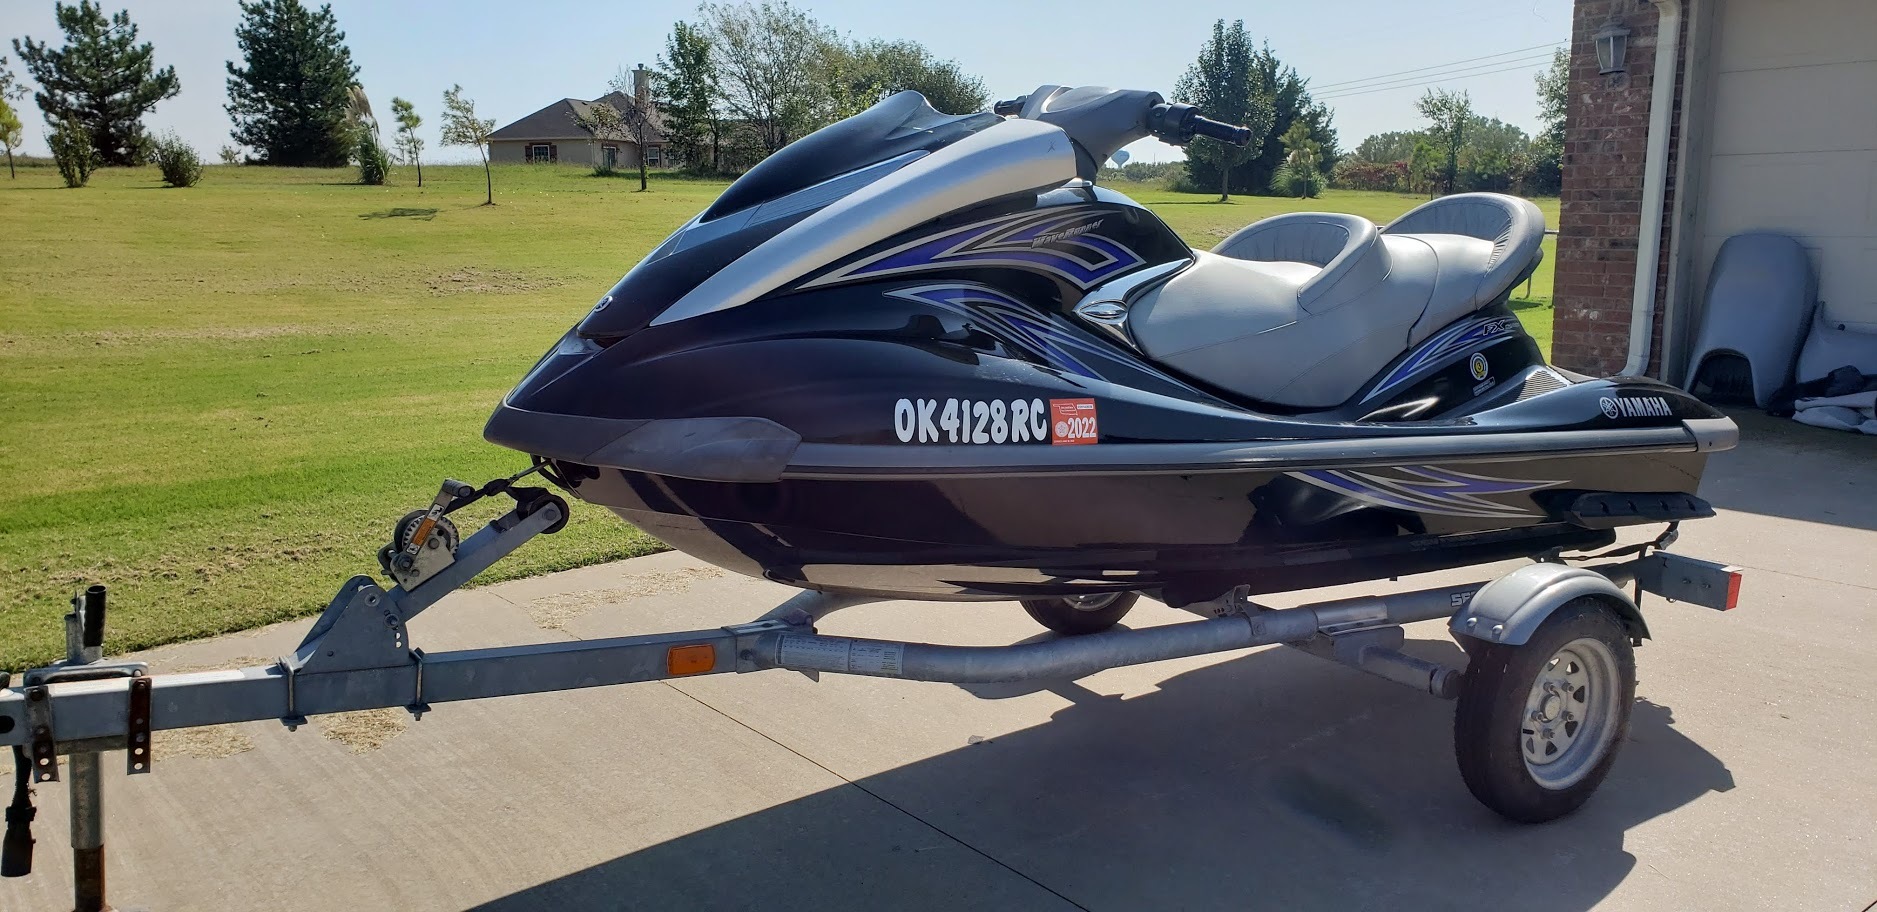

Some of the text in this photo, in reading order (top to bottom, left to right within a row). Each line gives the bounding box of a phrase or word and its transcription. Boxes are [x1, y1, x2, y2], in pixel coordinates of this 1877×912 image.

[1032, 219, 1104, 248] WaveRunner
[1483, 320, 1506, 336] FX
[1613, 397, 1673, 417] YAMAHA
[894, 398, 1047, 444] OK4128RC
[1068, 417, 1097, 438] 2022
